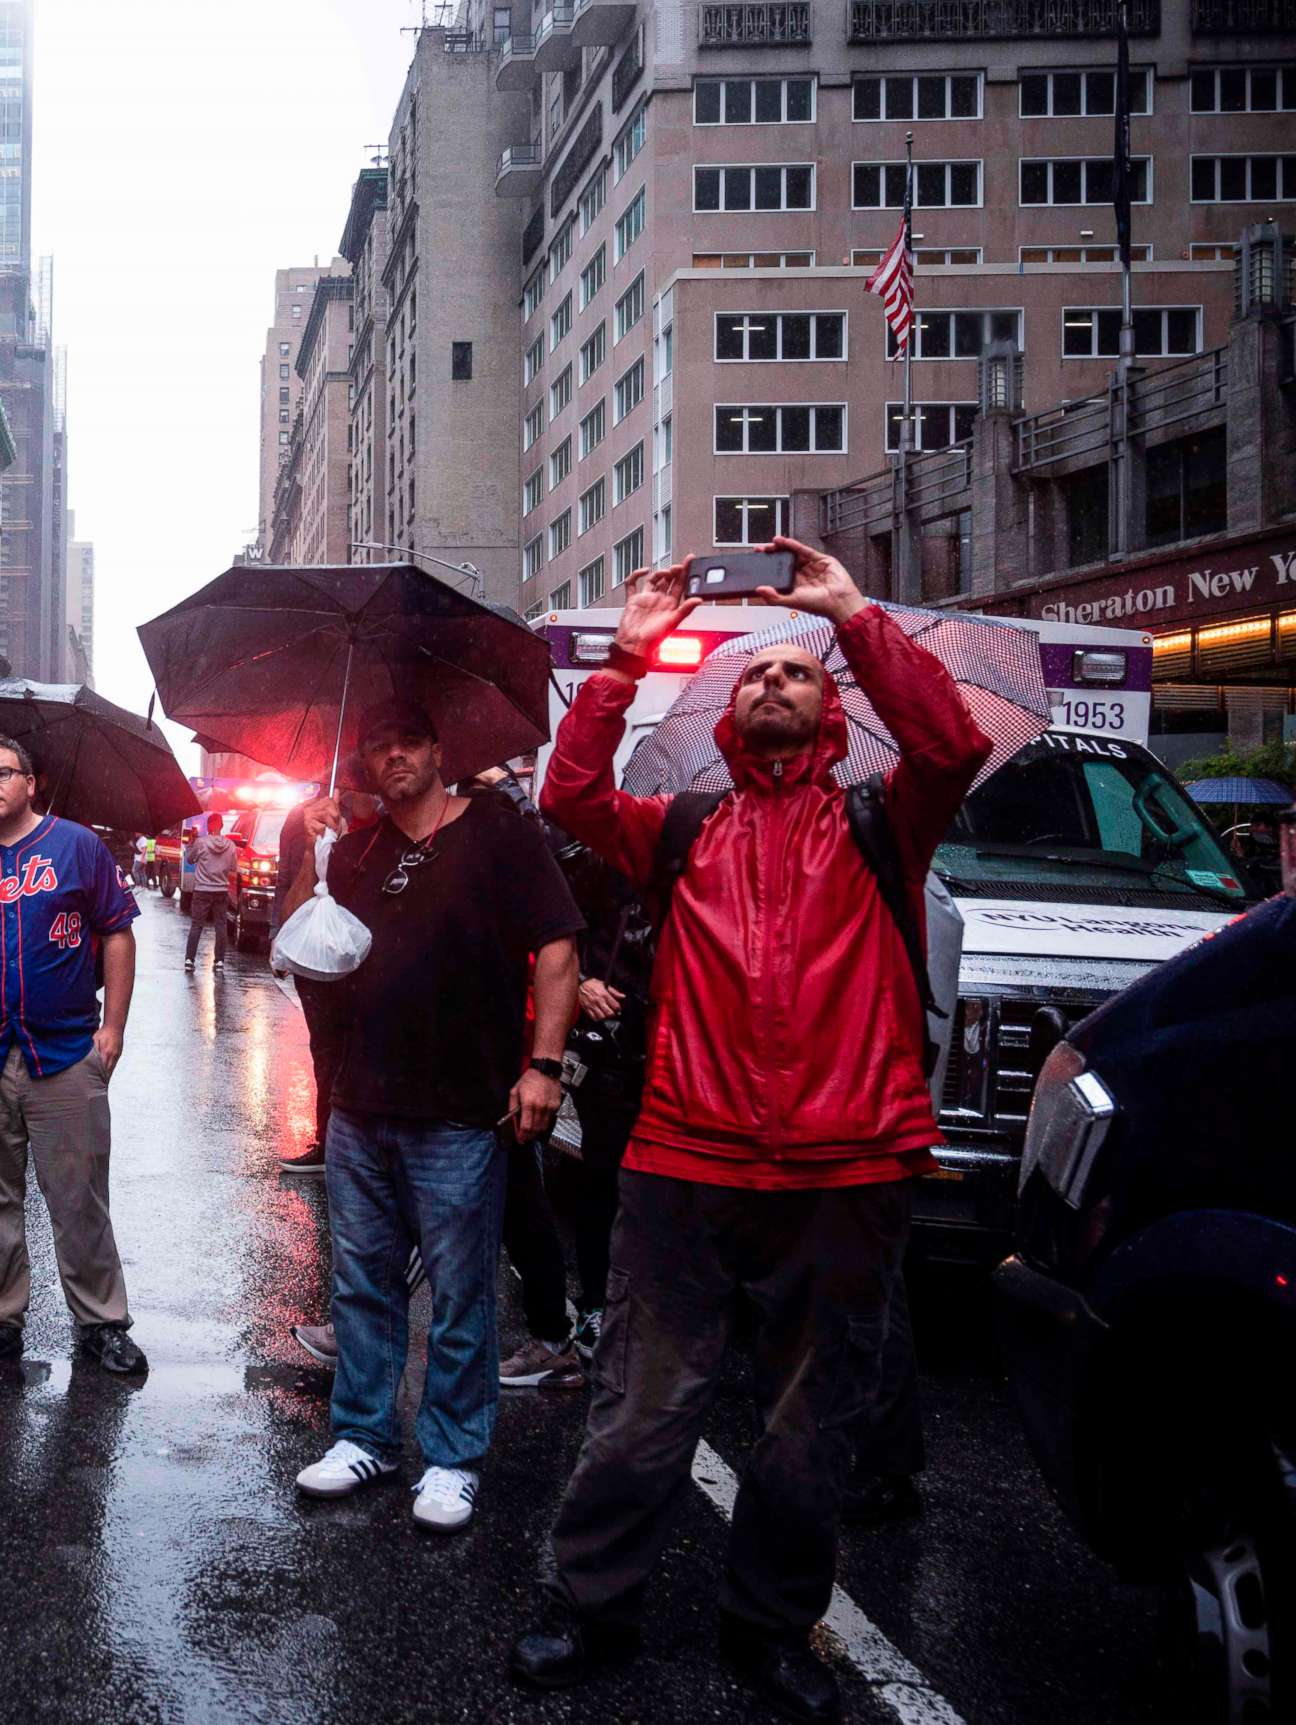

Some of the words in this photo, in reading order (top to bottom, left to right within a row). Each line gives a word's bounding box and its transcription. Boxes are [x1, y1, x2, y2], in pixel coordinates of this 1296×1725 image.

[1041, 584, 1177, 624] Sheraton
[1187, 565, 1259, 603] New
[1062, 700, 1125, 730] 1953
[49, 911, 82, 949] 48
[980, 912, 1058, 923] NYU
[1057, 915, 1208, 932] Langone
[1062, 923, 1184, 938] Health
